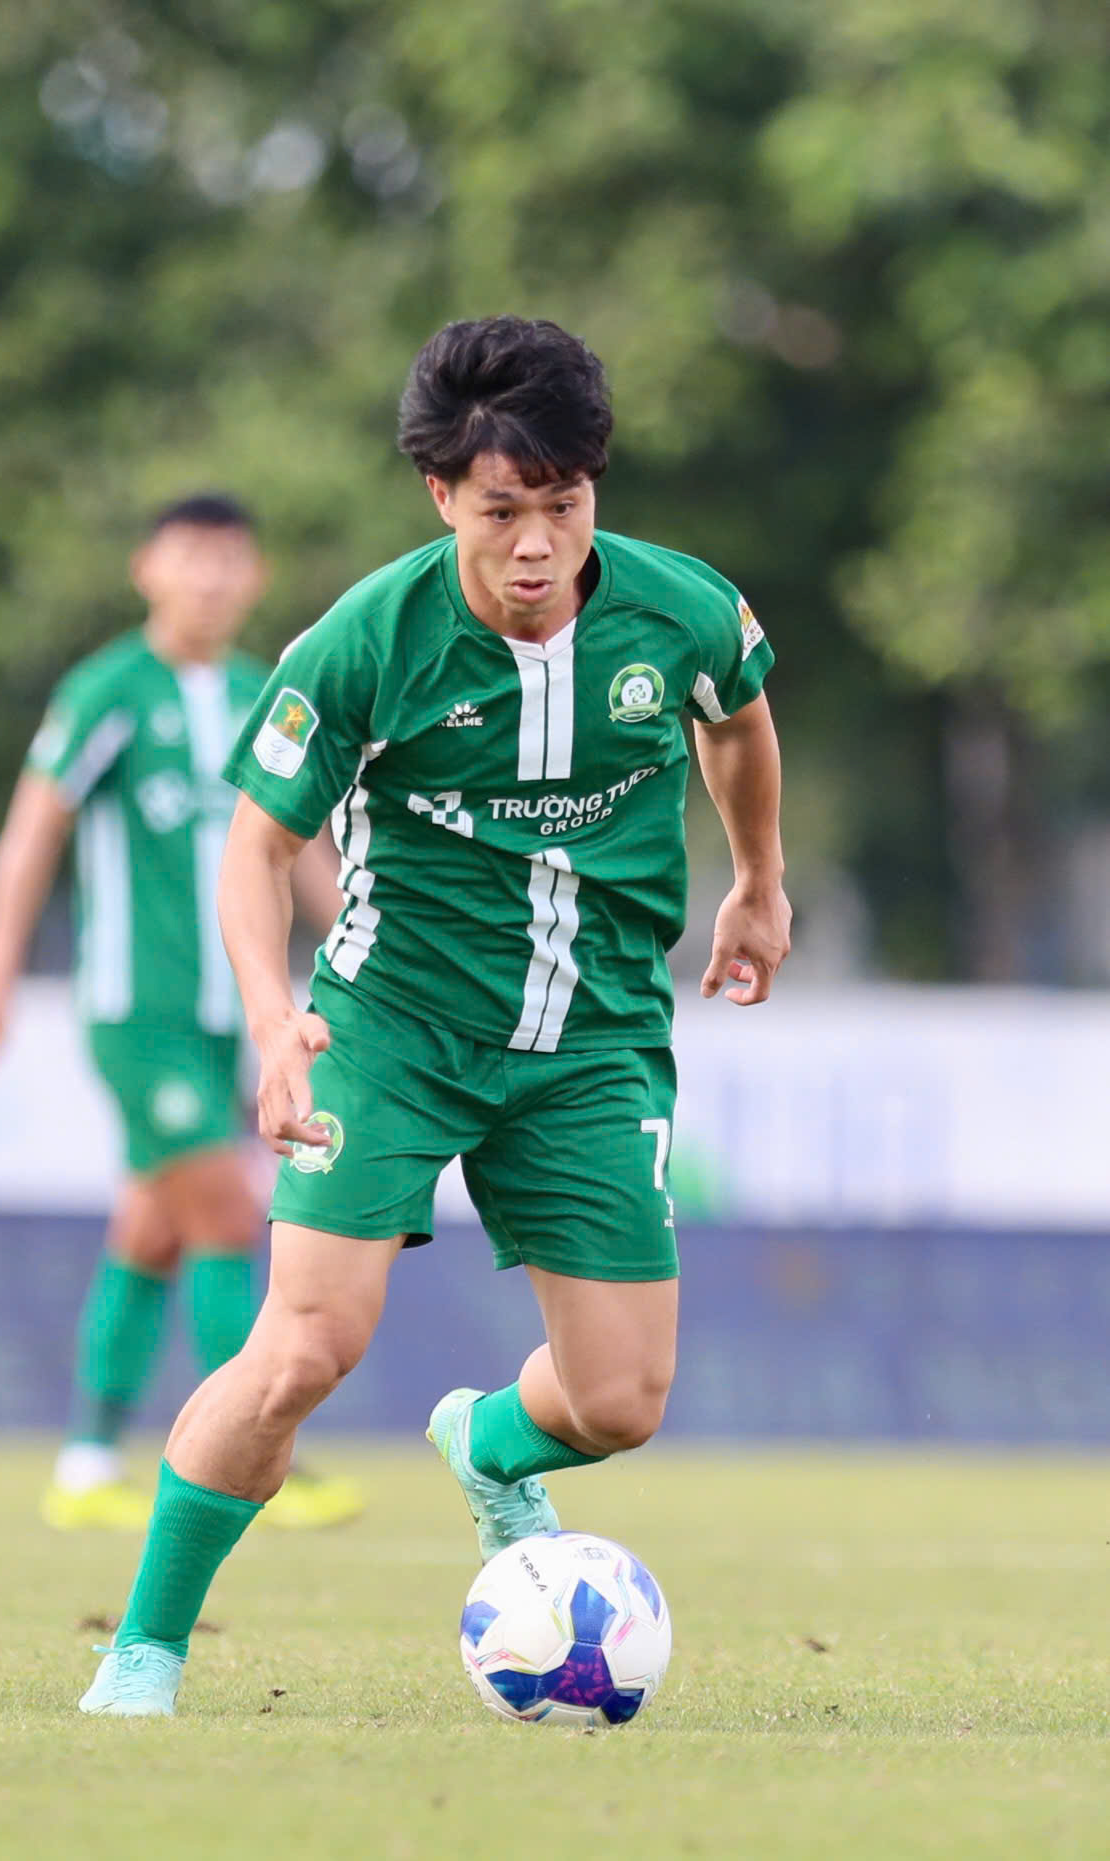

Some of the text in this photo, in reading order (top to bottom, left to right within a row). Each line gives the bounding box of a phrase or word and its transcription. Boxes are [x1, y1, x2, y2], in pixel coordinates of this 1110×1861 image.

[487, 794, 603, 820] TRƯỜNG
[540, 807, 613, 836] GROUP
[639, 1118, 670, 1191] 7
